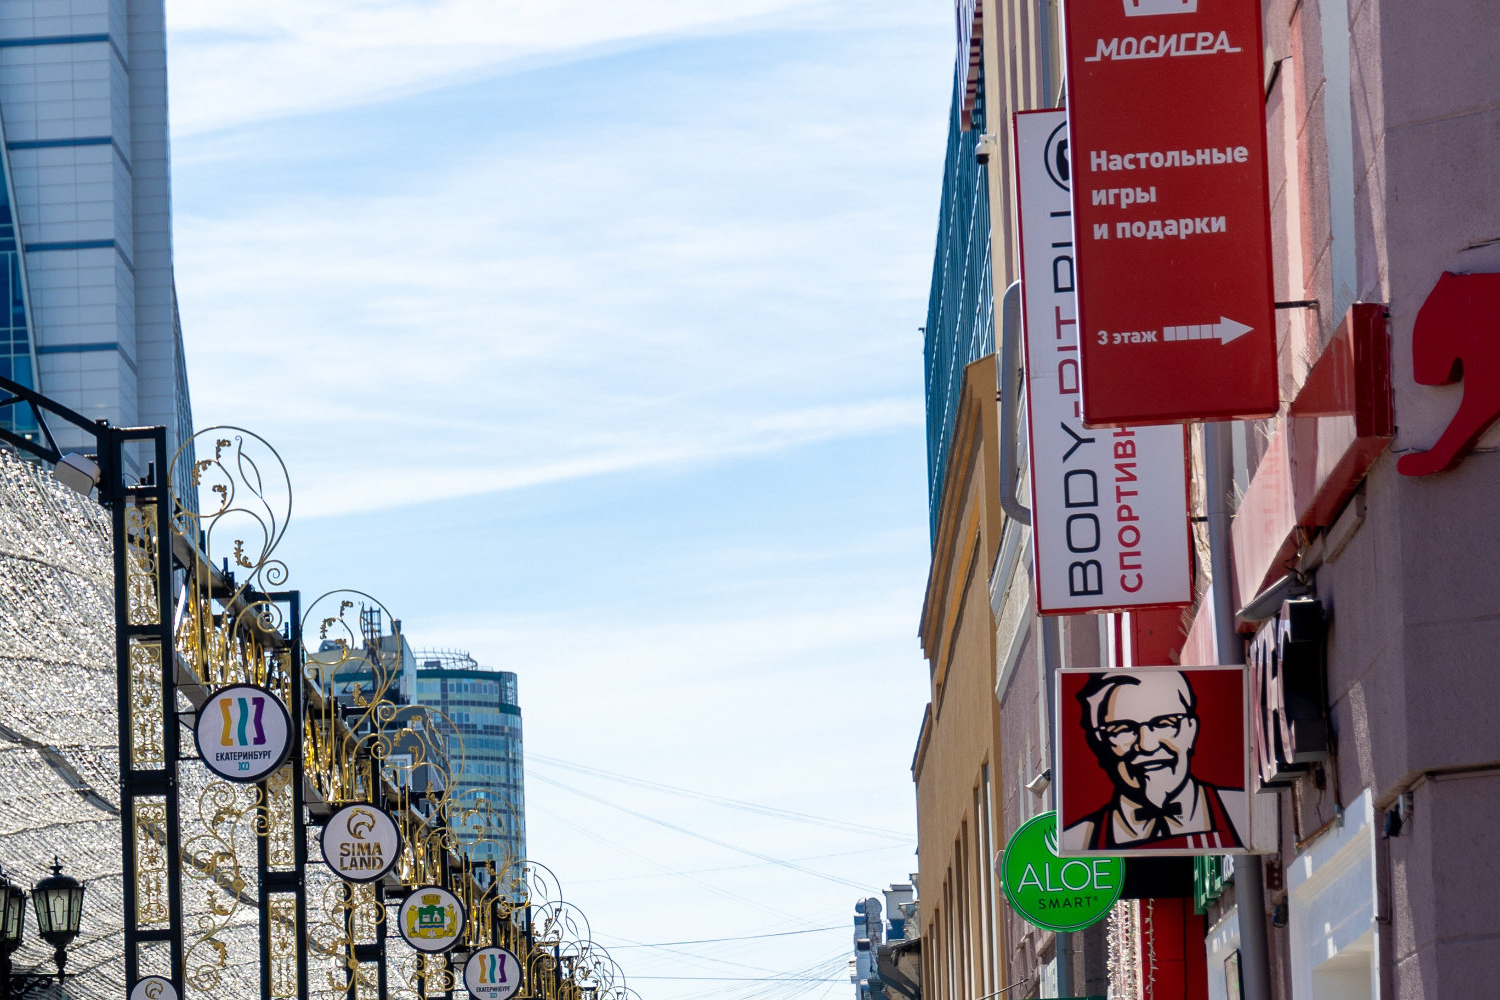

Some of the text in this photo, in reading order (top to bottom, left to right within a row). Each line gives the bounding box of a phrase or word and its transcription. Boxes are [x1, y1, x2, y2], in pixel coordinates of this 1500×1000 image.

[1090, 30, 1238, 61] МОСИГРА
[1090, 146, 1249, 172] Настольные
[1091, 186, 1156, 209] игры
[1093, 216, 1227, 240] и подарки
[1097, 329, 1158, 345] 3 этаж
[215, 750, 272, 762] ЕКАТЕРИНБУРГ
[338, 842, 383, 857] SIMA
[338, 856, 385, 871] LAND
[1016, 859, 1114, 893] ALOE
[476, 985, 512, 993] ЕКАТЕРИНБУРГ
